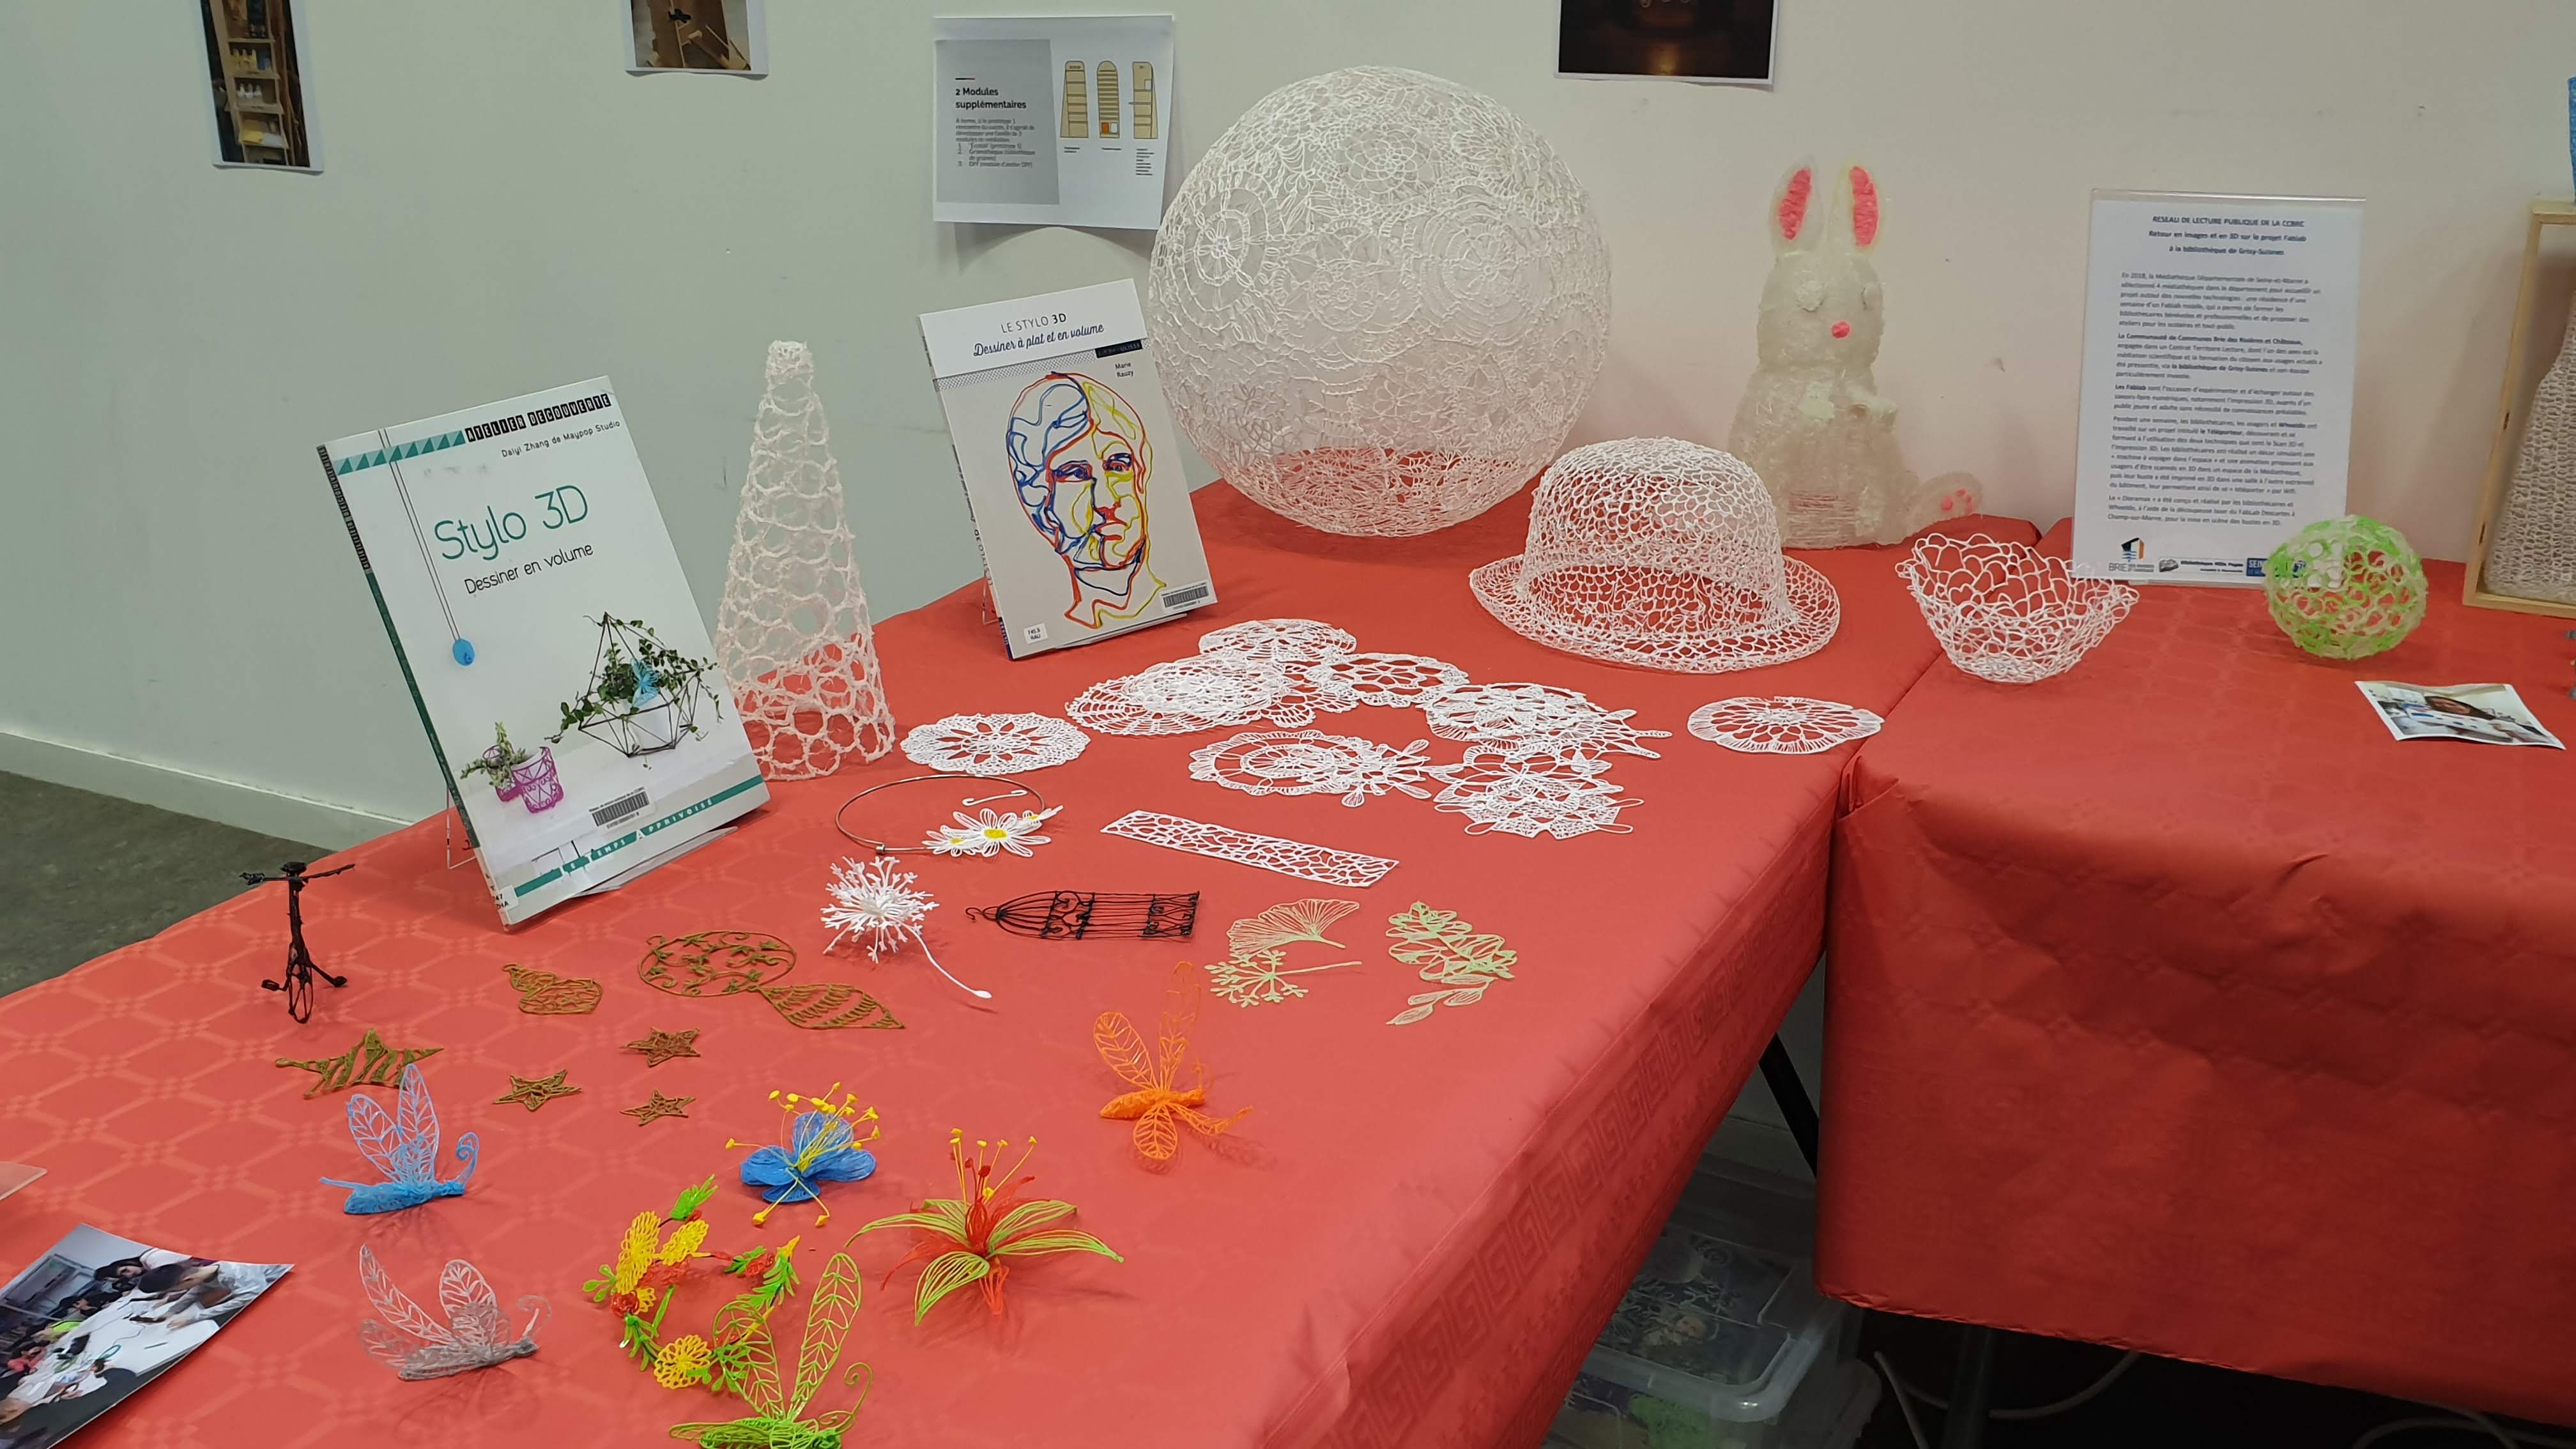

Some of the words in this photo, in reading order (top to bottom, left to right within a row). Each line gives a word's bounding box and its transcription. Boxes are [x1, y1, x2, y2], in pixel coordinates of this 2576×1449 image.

[956, 100, 1027, 110] supplémentaires
[1001, 323, 1013, 333] LE
[1016, 316, 1049, 332] STYLO
[1052, 313, 1067, 324] 3D
[974, 341, 1016, 356] Dessiner
[1018, 339, 1024, 348] à
[1026, 334, 1046, 349] plat
[1046, 333, 1056, 342] et
[1057, 331, 1070, 341] en
[1071, 324, 1105, 338] volume
[465, 415, 526, 442] ATELIER
[527, 394, 611, 426] DECOUVERTE
[524, 440, 549, 452] Zhang
[552, 436, 561, 444] de
[563, 426, 594, 441] Maypop
[595, 420, 620, 432] Studio
[434, 505, 526, 560] Stylo
[535, 485, 588, 529] 3D
[464, 567, 519, 594] Dessiner
[524, 561, 542, 575] en
[544, 544, 594, 567] volume
